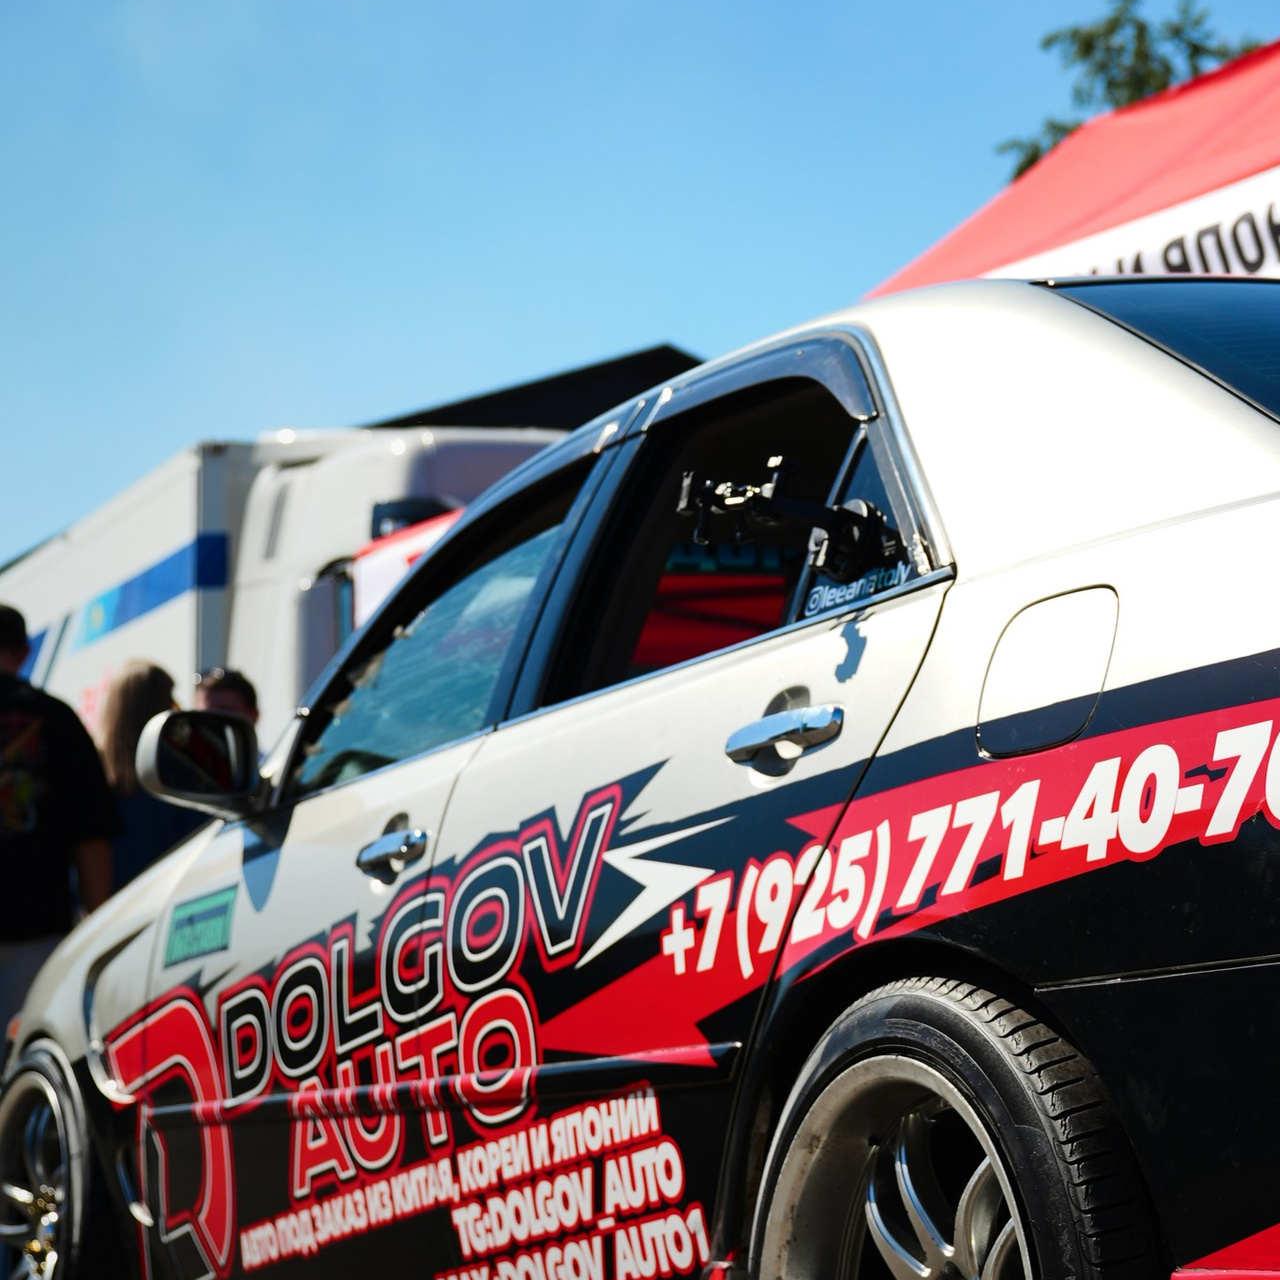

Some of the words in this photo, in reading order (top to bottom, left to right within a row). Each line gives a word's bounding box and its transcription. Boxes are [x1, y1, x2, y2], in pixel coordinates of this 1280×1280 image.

[221, 804, 614, 1108] DOLGOV
[240, 1222, 279, 1270] АВТО
[276, 1209, 318, 1255] ПОД
[312, 1188, 368, 1245] ЗАКАЗ
[366, 1180, 393, 1224] ИЗ
[529, 1123, 550, 1170] И
[550, 1086, 660, 1163] ЯПОНИИ
[293, 987, 536, 1197] AUTO
